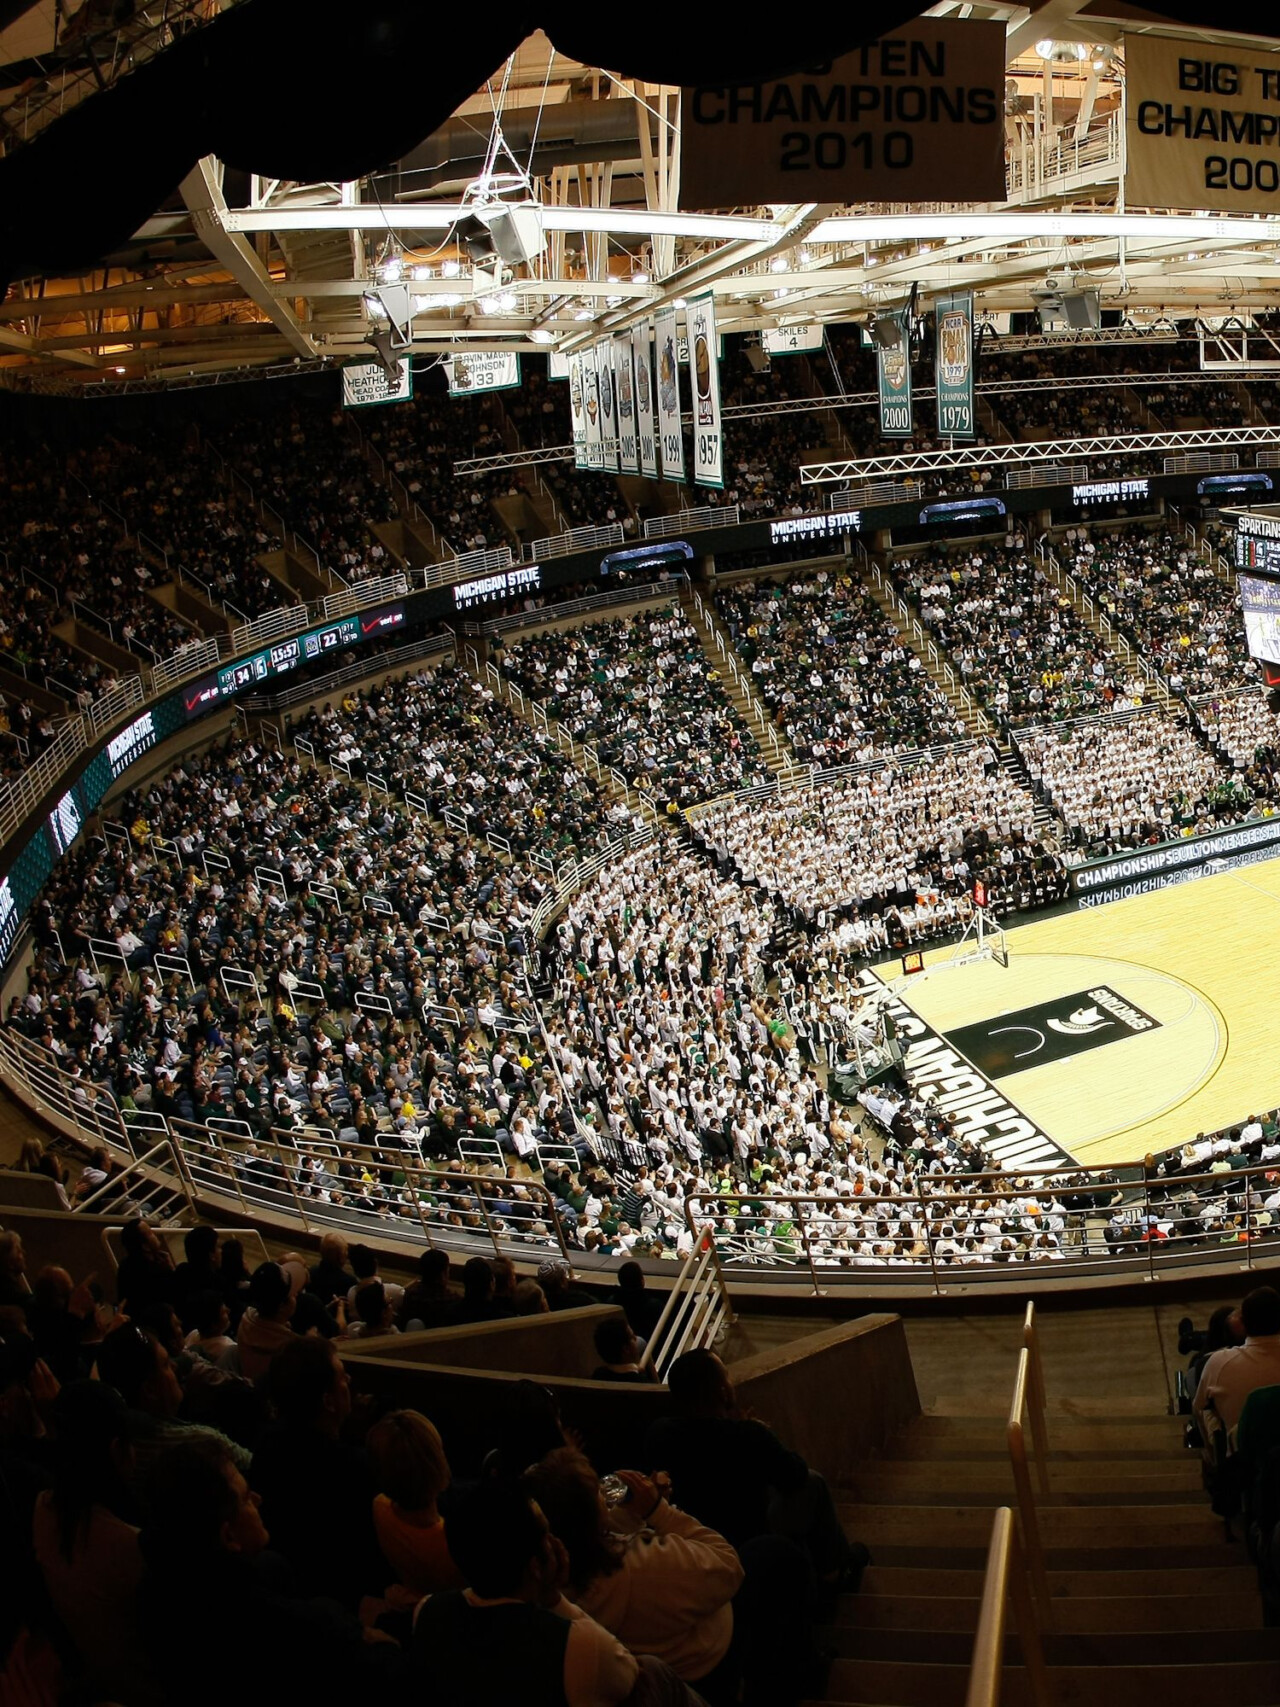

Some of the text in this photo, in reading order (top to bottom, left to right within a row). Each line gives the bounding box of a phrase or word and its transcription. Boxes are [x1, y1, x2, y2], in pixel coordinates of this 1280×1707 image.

[860, 40, 945, 76] TEN
[1178, 58, 1238, 96] BIG
[692, 83, 996, 124] CHAMPIONS
[780, 132, 913, 170] 2010
[778, 326, 808, 337] SKILES
[790, 337, 798, 348] 4
[476, 372, 494, 386] 33
[946, 365, 962, 376] 1979
[884, 407, 908, 428] 2000
[942, 406, 970, 430] 1979
[664, 434, 680, 463] 1999
[698, 434, 719, 466] 1957
[1072, 479, 1149, 498] MICHIGAN STATE
[1073, 492, 1148, 506] UNIVERSITY
[770, 511, 860, 536] MICHIGAN STATE
[772, 525, 860, 544] UNIVERSITY
[454, 566, 540, 601] MICHIGAN STATE
[456, 581, 541, 610] UNIVERSITY
[323, 633, 337, 647] 22
[272, 643, 297, 663] 15:57
[237, 668, 250, 684] 34
[107, 711, 154, 766] MICHIGAN STATE
[112, 732, 156, 779] UNIVERSITY
[1088, 987, 1154, 1031] SPARTANS
